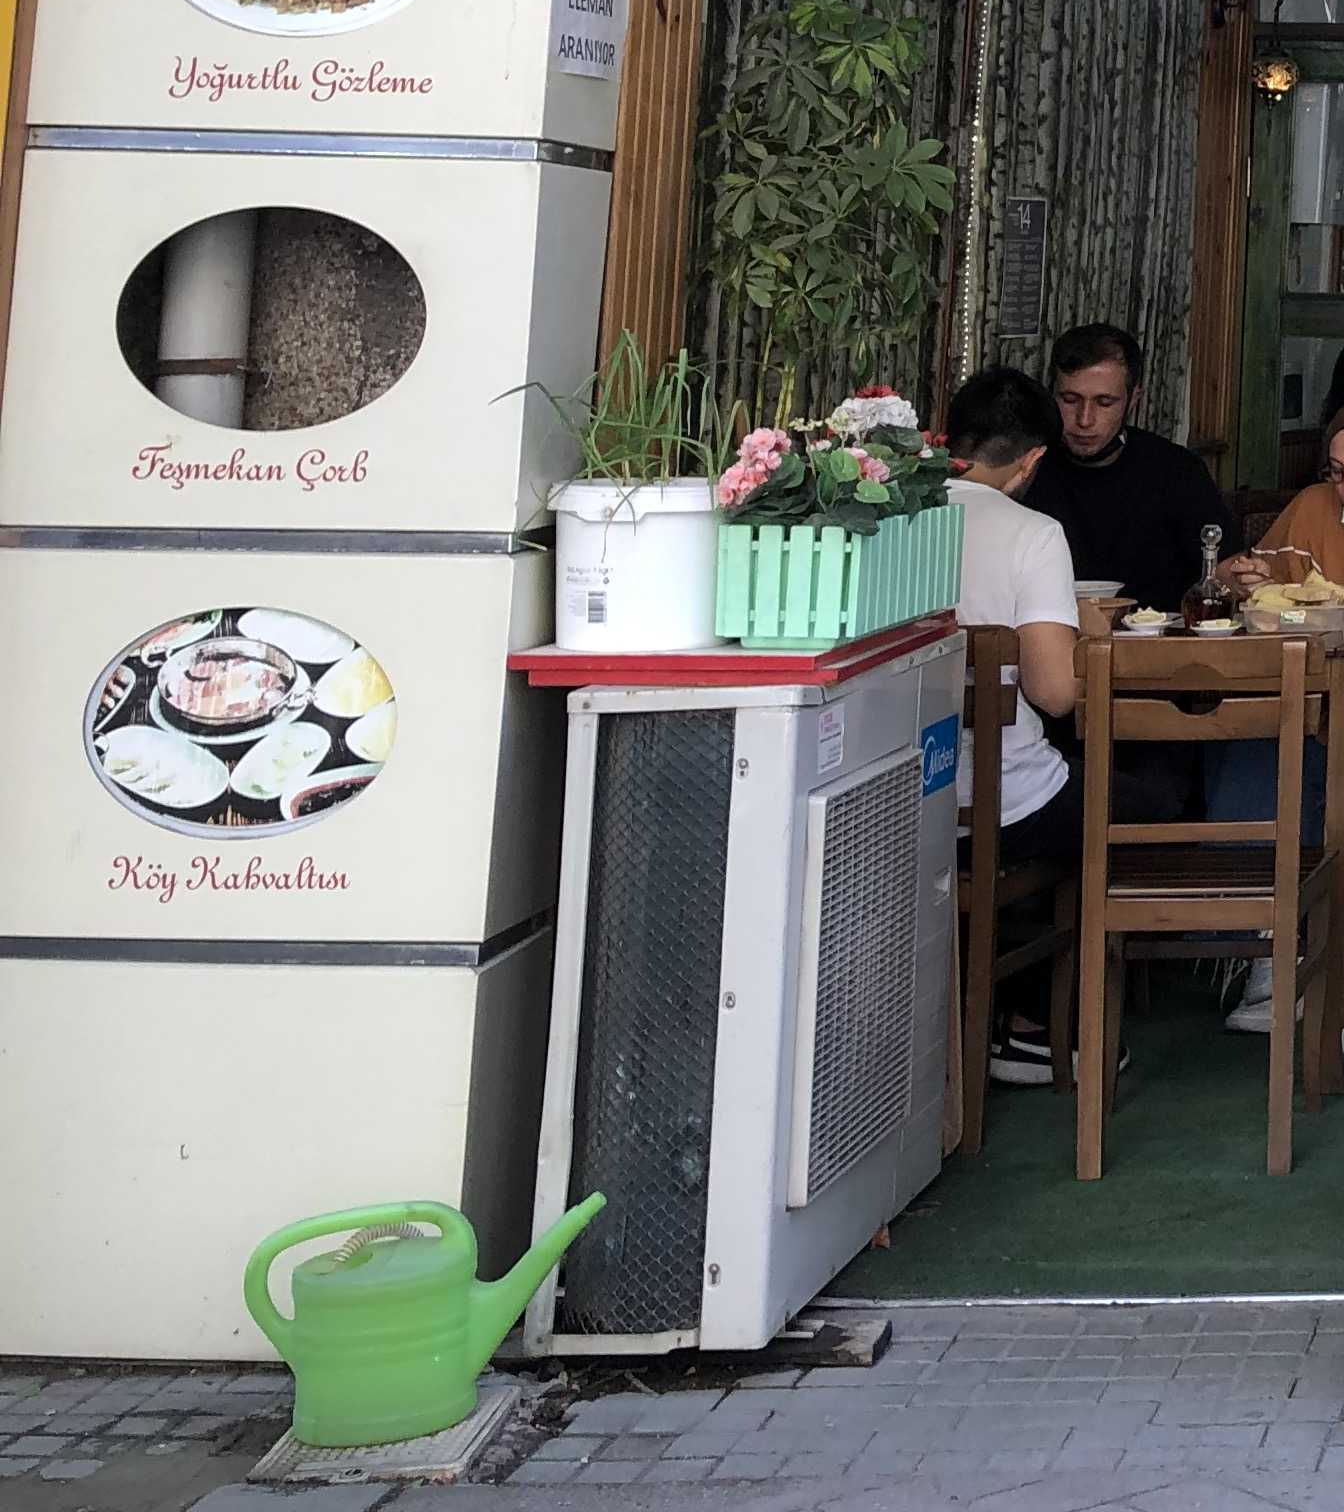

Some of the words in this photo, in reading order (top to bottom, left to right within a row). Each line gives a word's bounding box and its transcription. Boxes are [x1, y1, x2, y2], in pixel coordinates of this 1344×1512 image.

[558, 34, 615, 66] ARANIYOR
[168, 55, 302, 102] Yoğurtlu
[311, 59, 433, 102] Gözleme
[131, 441, 286, 490] Feşmekan
[107, 855, 177, 904] Köy
[185, 855, 351, 891] Kahvaltısı
